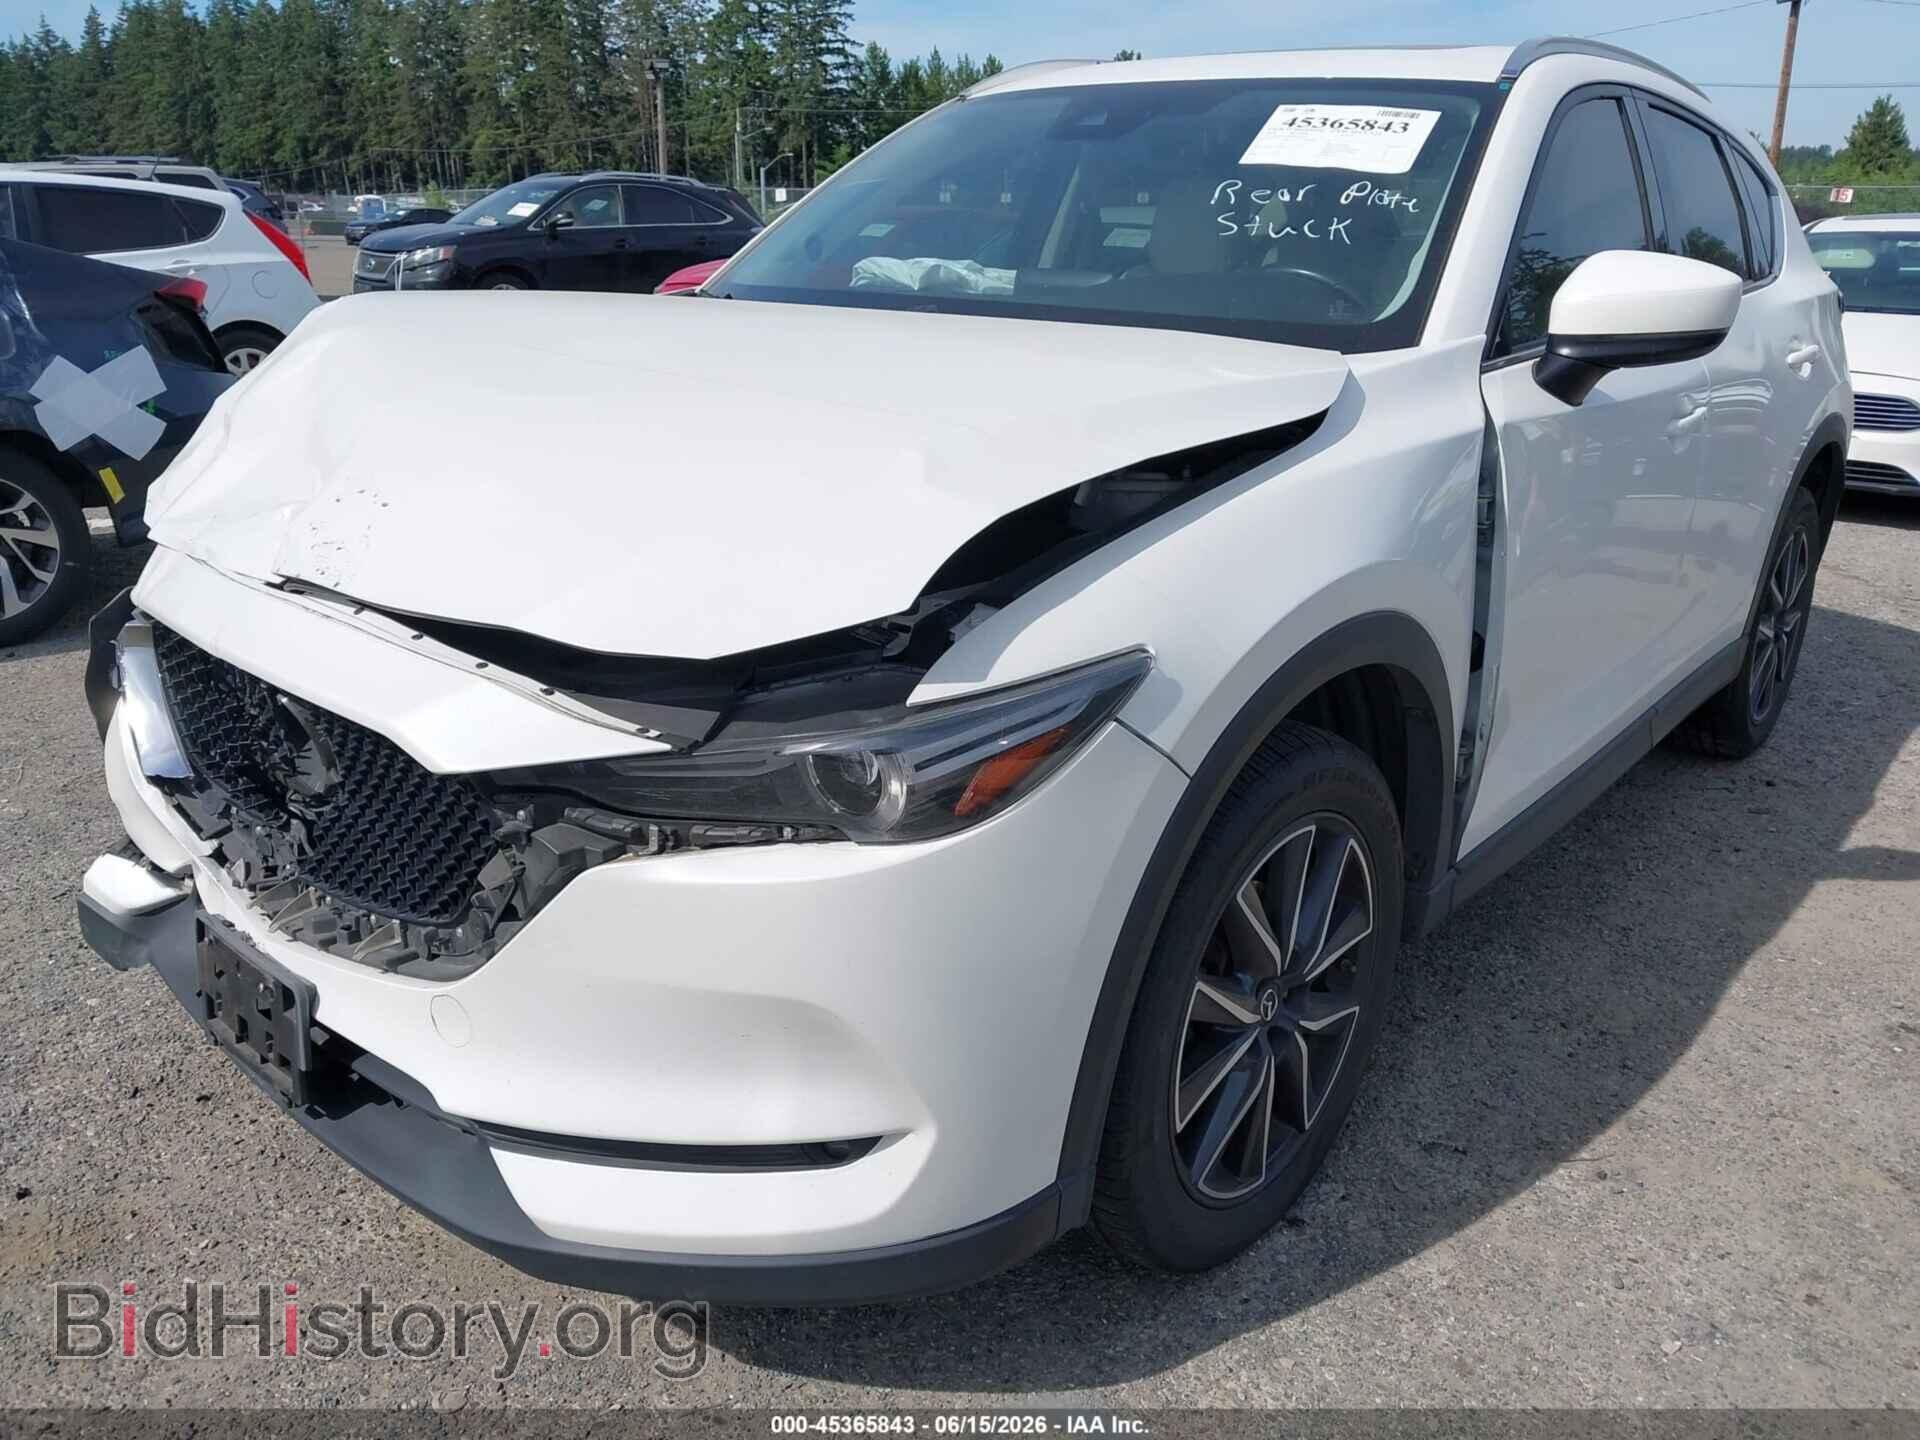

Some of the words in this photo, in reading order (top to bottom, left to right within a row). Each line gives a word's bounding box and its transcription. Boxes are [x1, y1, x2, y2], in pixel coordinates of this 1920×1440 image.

[1282, 116, 1410, 134] 45365843
[1210, 180, 1318, 204] Rear
[1340, 181, 1420, 213] Plate
[1834, 188, 1849, 201] 15
